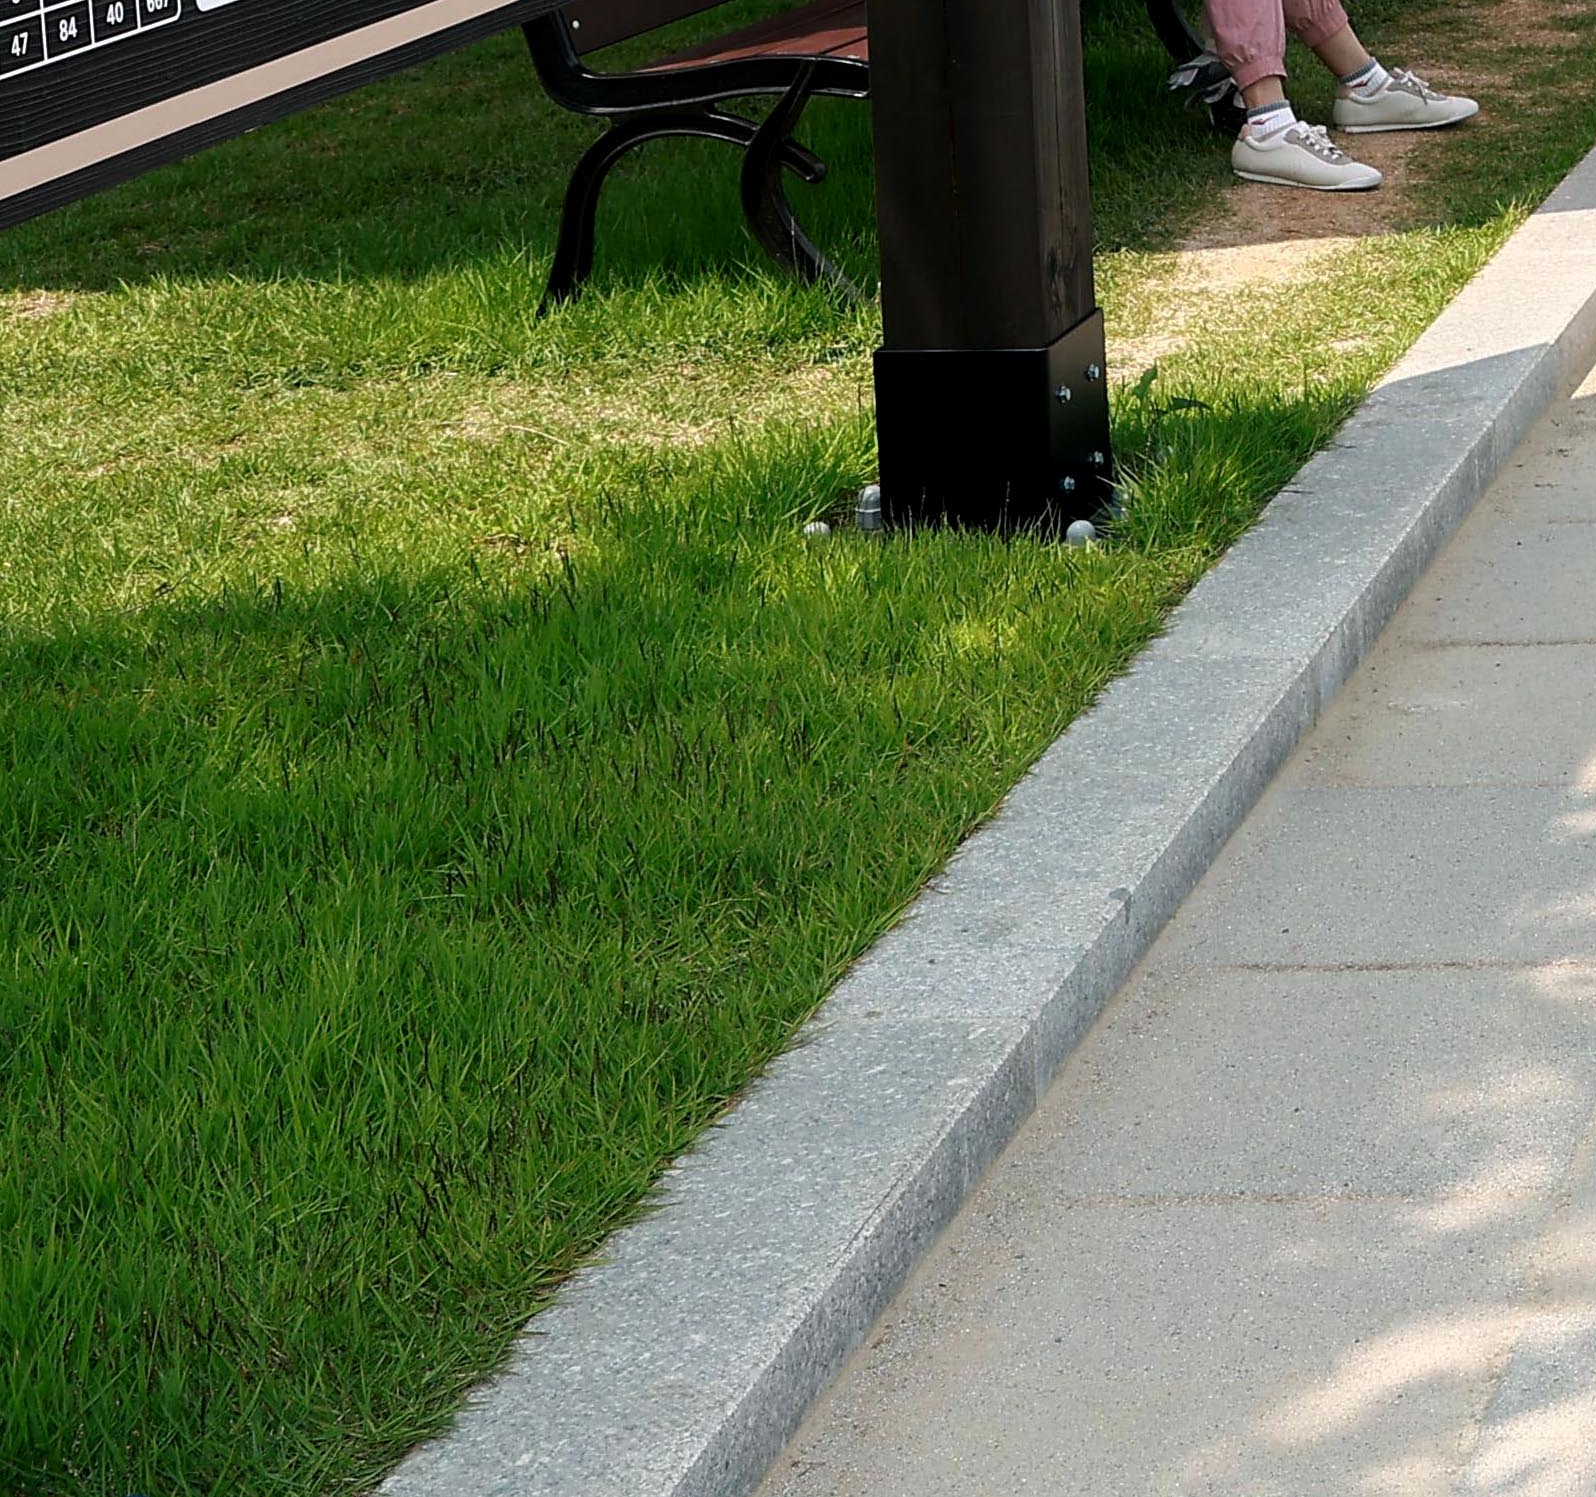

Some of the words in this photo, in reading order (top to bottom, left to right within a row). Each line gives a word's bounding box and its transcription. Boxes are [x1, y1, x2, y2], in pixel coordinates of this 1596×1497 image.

[11, 32, 28, 56] 47
[59, 16, 78, 41] 84
[106, 1, 124, 25] 40
